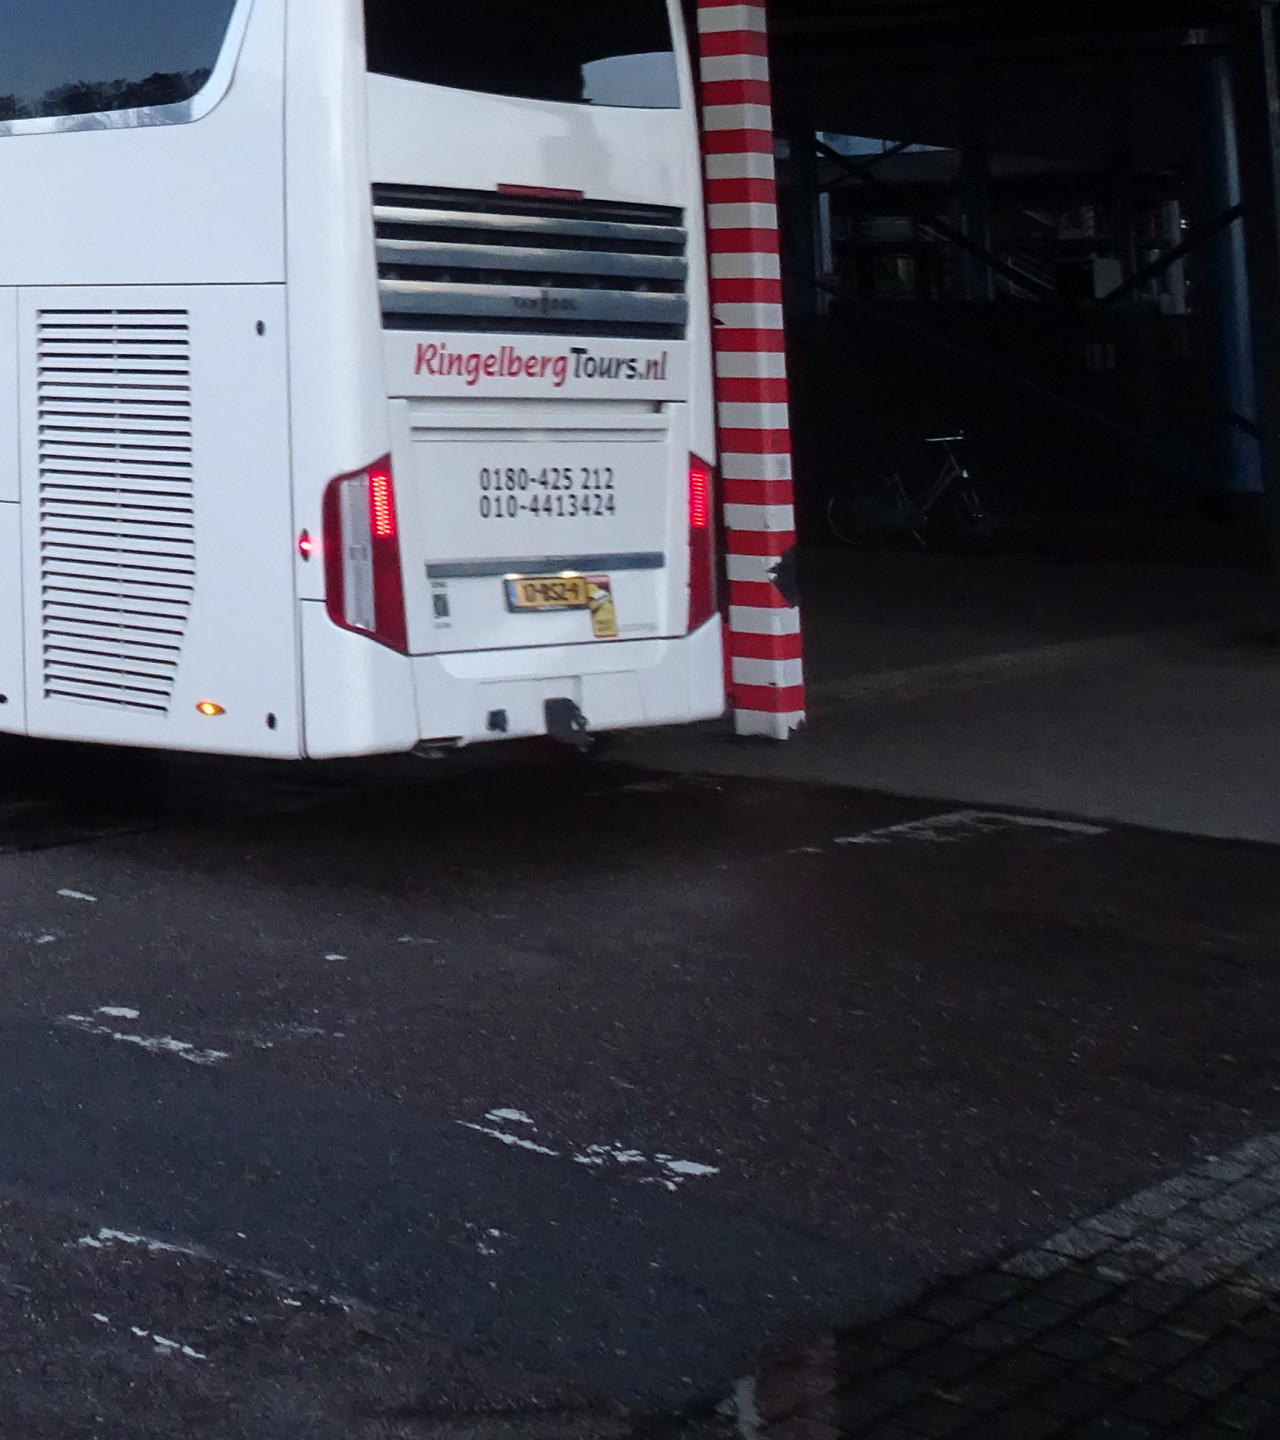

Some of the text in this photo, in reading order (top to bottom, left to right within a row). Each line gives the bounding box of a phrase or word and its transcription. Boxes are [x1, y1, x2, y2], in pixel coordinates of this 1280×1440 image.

[414, 341, 668, 388] RingelbergTours.nl
[480, 467, 615, 491] 0180-425 212
[480, 493, 617, 518] 010-4413424
